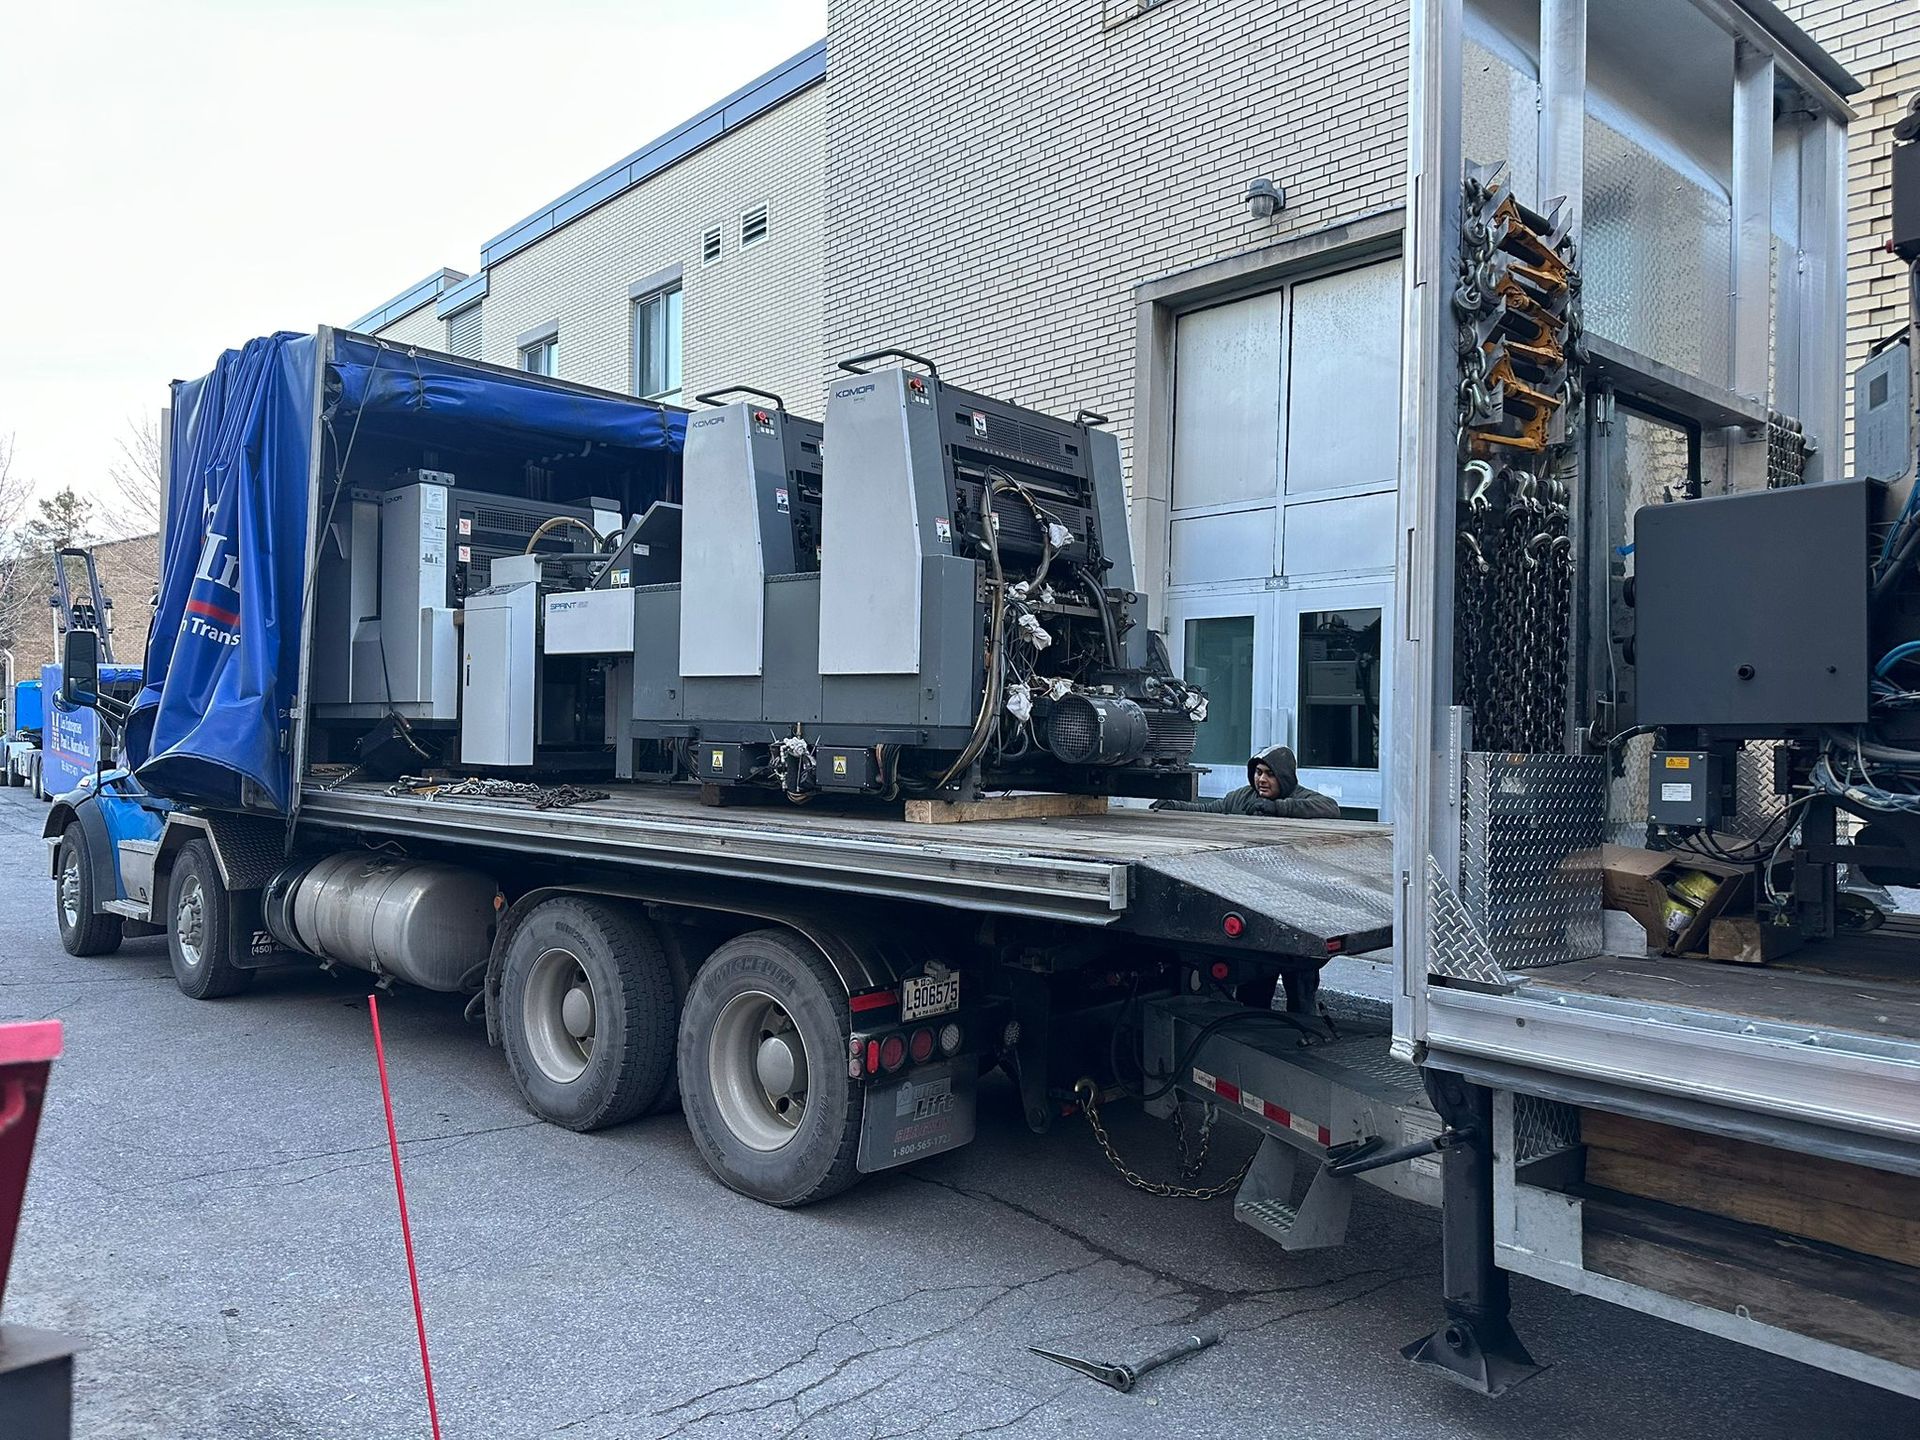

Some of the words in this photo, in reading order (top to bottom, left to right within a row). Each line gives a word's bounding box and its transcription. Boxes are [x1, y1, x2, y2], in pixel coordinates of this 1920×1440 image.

[834, 383, 876, 400] KOMORI
[692, 415, 726, 429] KOMORI
[906, 981, 958, 1011] L906575
